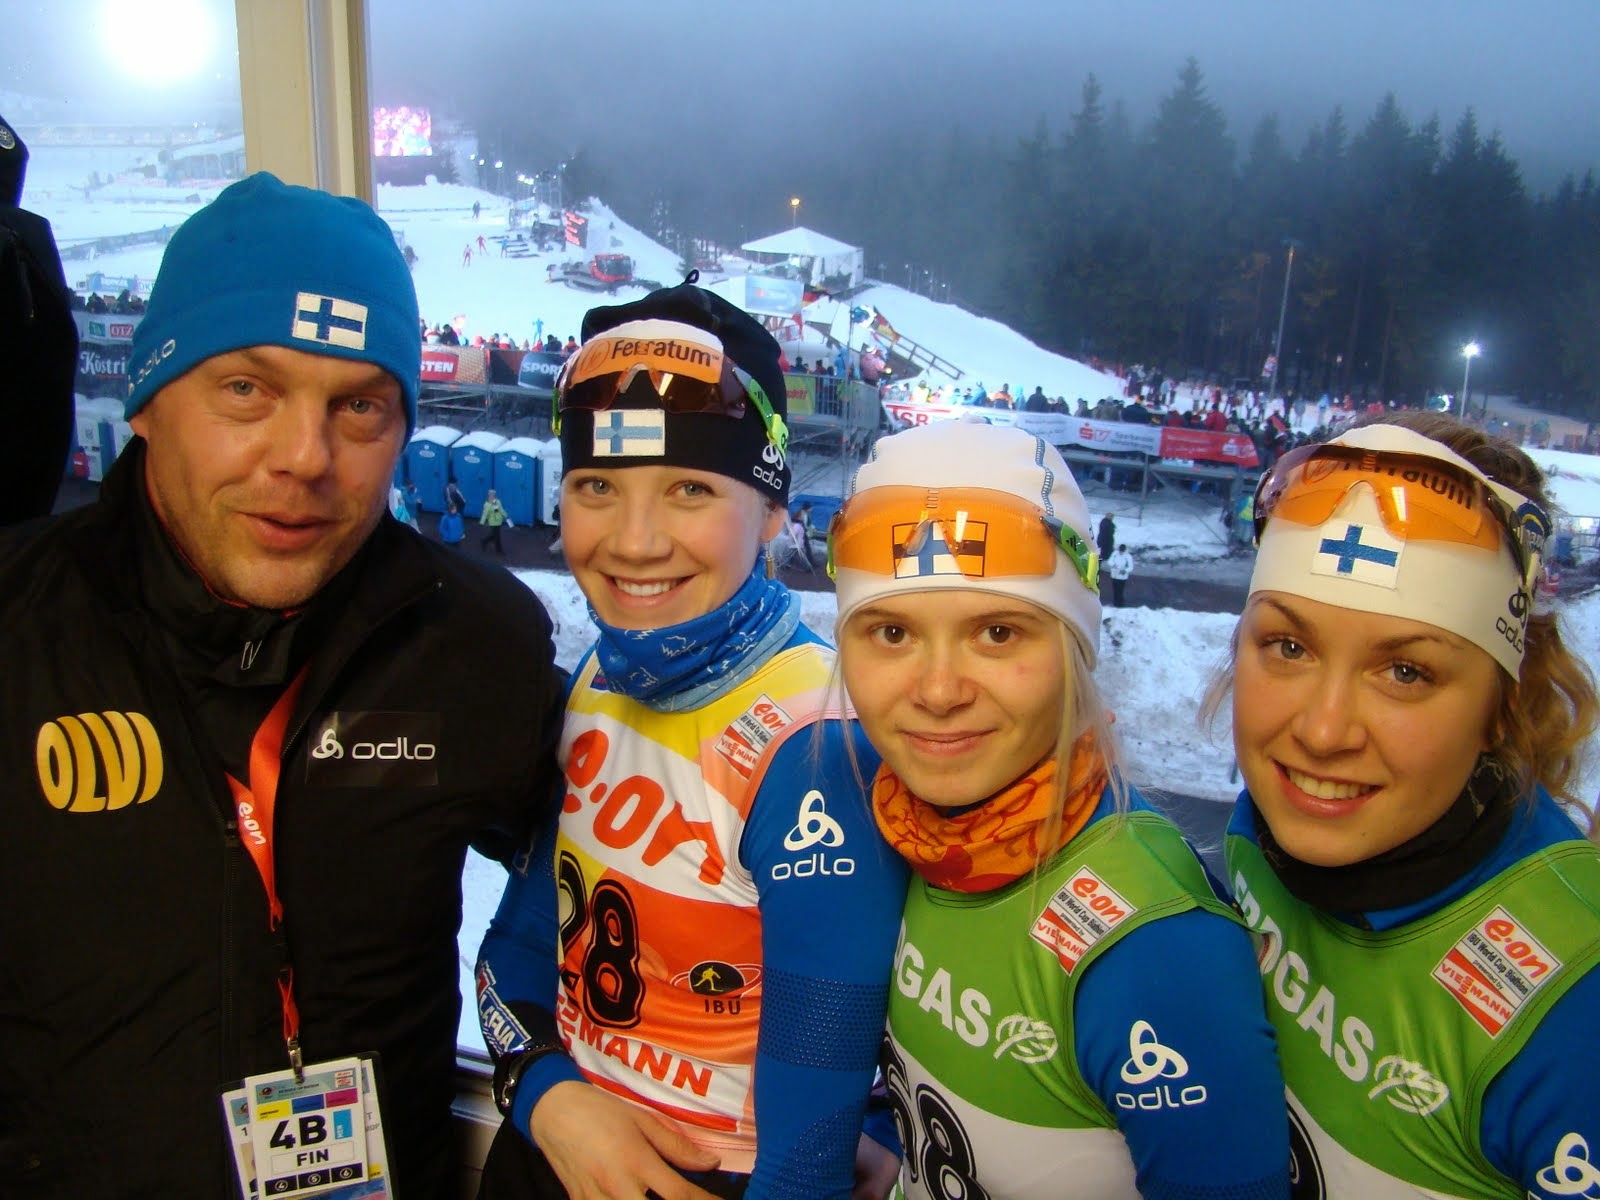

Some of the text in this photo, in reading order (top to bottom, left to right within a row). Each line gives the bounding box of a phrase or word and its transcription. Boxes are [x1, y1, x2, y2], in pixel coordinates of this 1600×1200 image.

[110, 325, 133, 337] OTZ
[752, 464, 783, 491] odlo
[36, 710, 164, 813] OLVI
[351, 736, 437, 761] odlo
[771, 853, 856, 881] odlo
[1065, 898, 1081, 915] World
[1078, 908, 1090, 924] Cup
[1467, 932, 1529, 996] IBU World Cup Biathlon
[1472, 959, 1504, 991] presented by
[895, 924, 992, 1047] GAS
[1441, 962, 1511, 1020] VIESSMANN
[704, 998, 742, 1016] IBU
[1115, 1085, 1208, 1110] odlo
[269, 1114, 328, 1150] 4B
[296, 1148, 330, 1167] FIN
